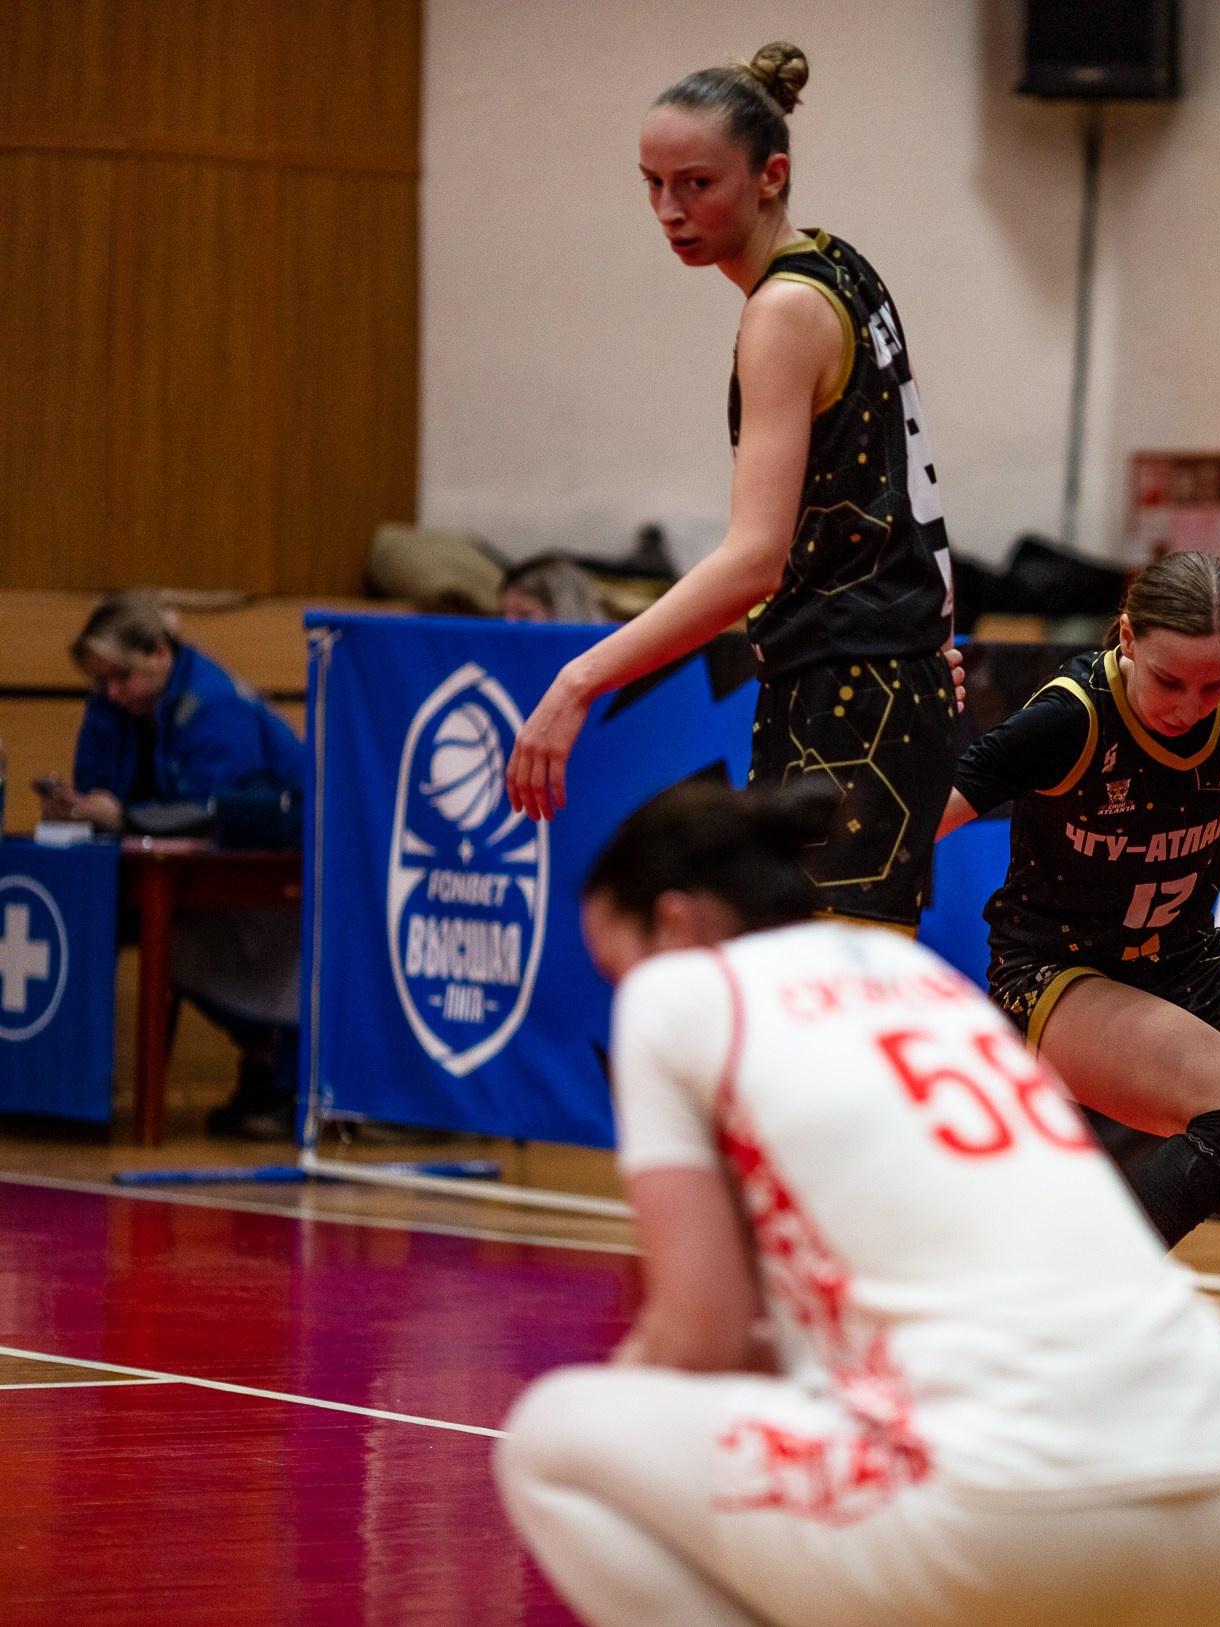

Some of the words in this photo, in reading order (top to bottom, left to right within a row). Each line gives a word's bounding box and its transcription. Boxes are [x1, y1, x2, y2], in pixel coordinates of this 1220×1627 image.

[427, 869, 511, 908] FONBET
[1122, 872, 1198, 929] 12
[406, 915, 522, 985] ВЫСШАЯ
[874, 1029, 1100, 1162] 58
